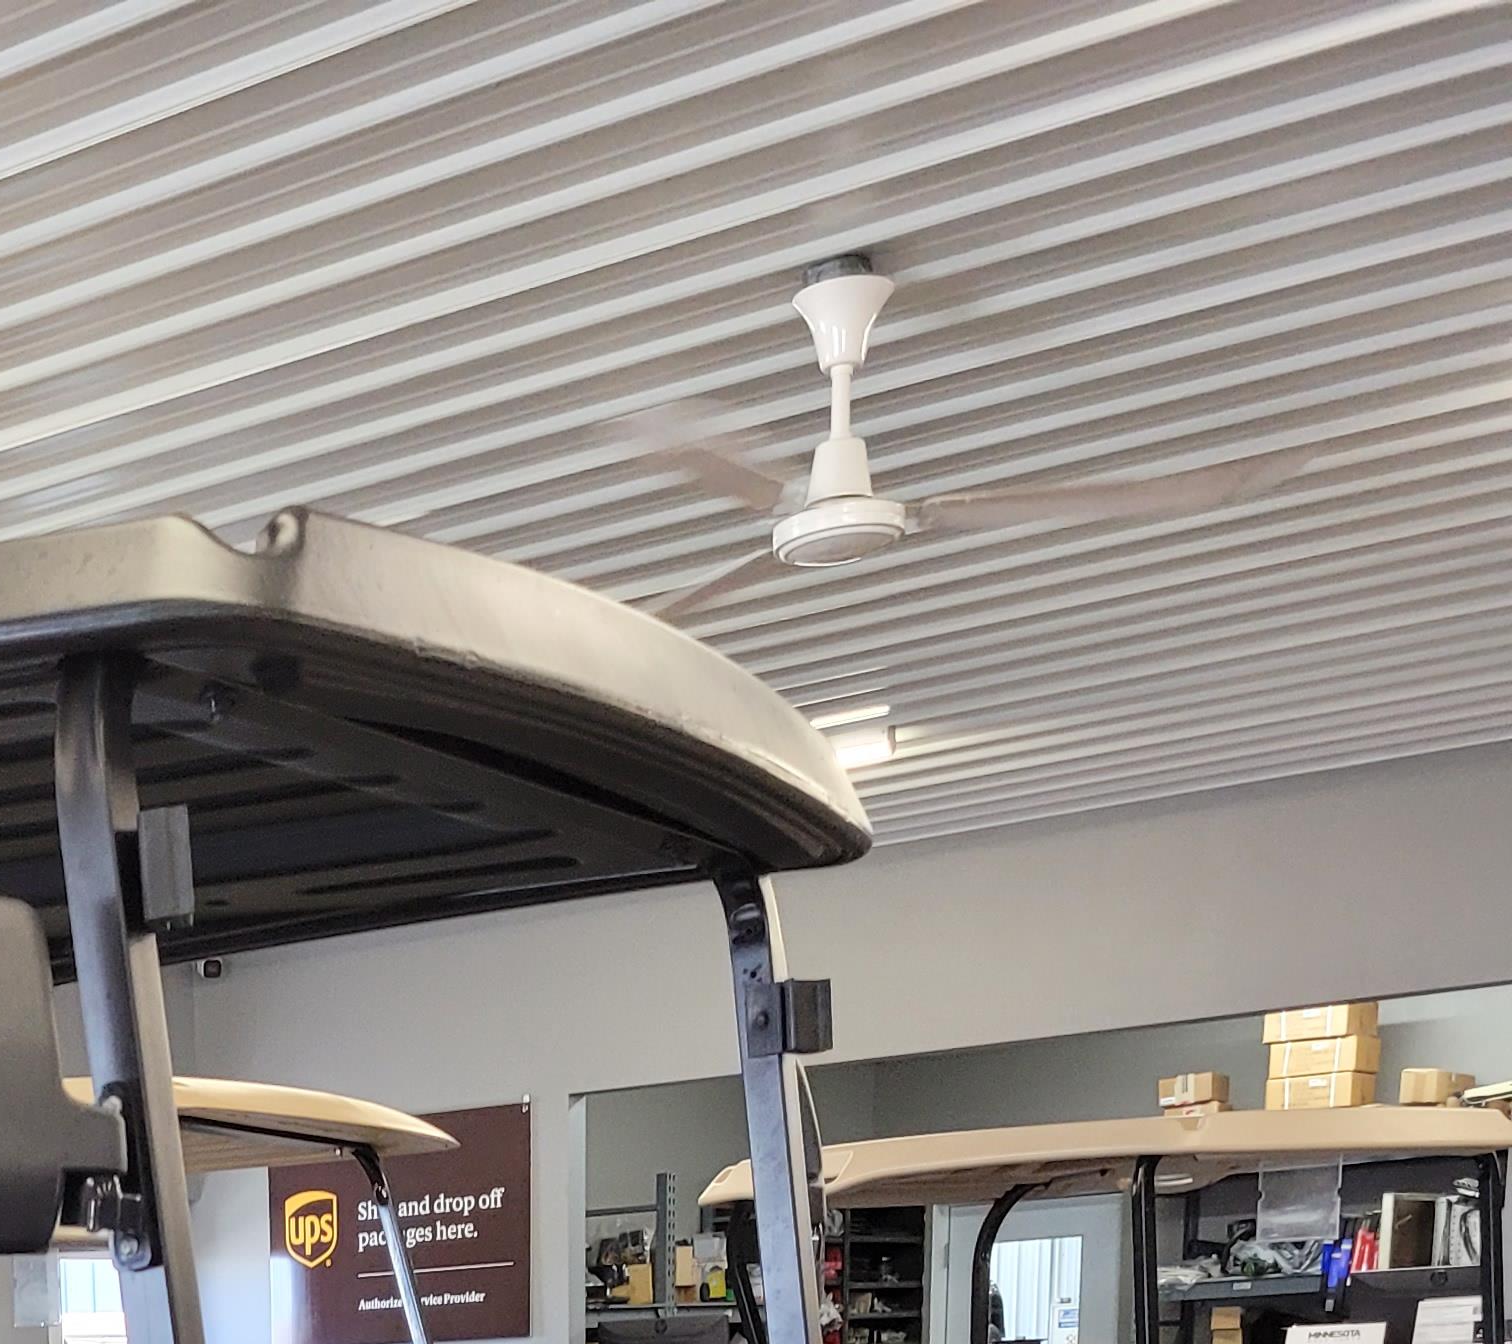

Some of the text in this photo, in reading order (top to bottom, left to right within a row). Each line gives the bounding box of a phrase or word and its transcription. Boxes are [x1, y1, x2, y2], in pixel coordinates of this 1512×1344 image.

[398, 1194, 430, 1218] and
[433, 1193, 475, 1217] drop
[478, 1187, 505, 1210] off
[289, 1212, 333, 1256] ups
[357, 1220, 479, 1252] pacges here.
[358, 1297, 403, 1311] Authorize
[444, 1290, 486, 1305] Provider
[1308, 1329, 1361, 1339] MINNESOTA
